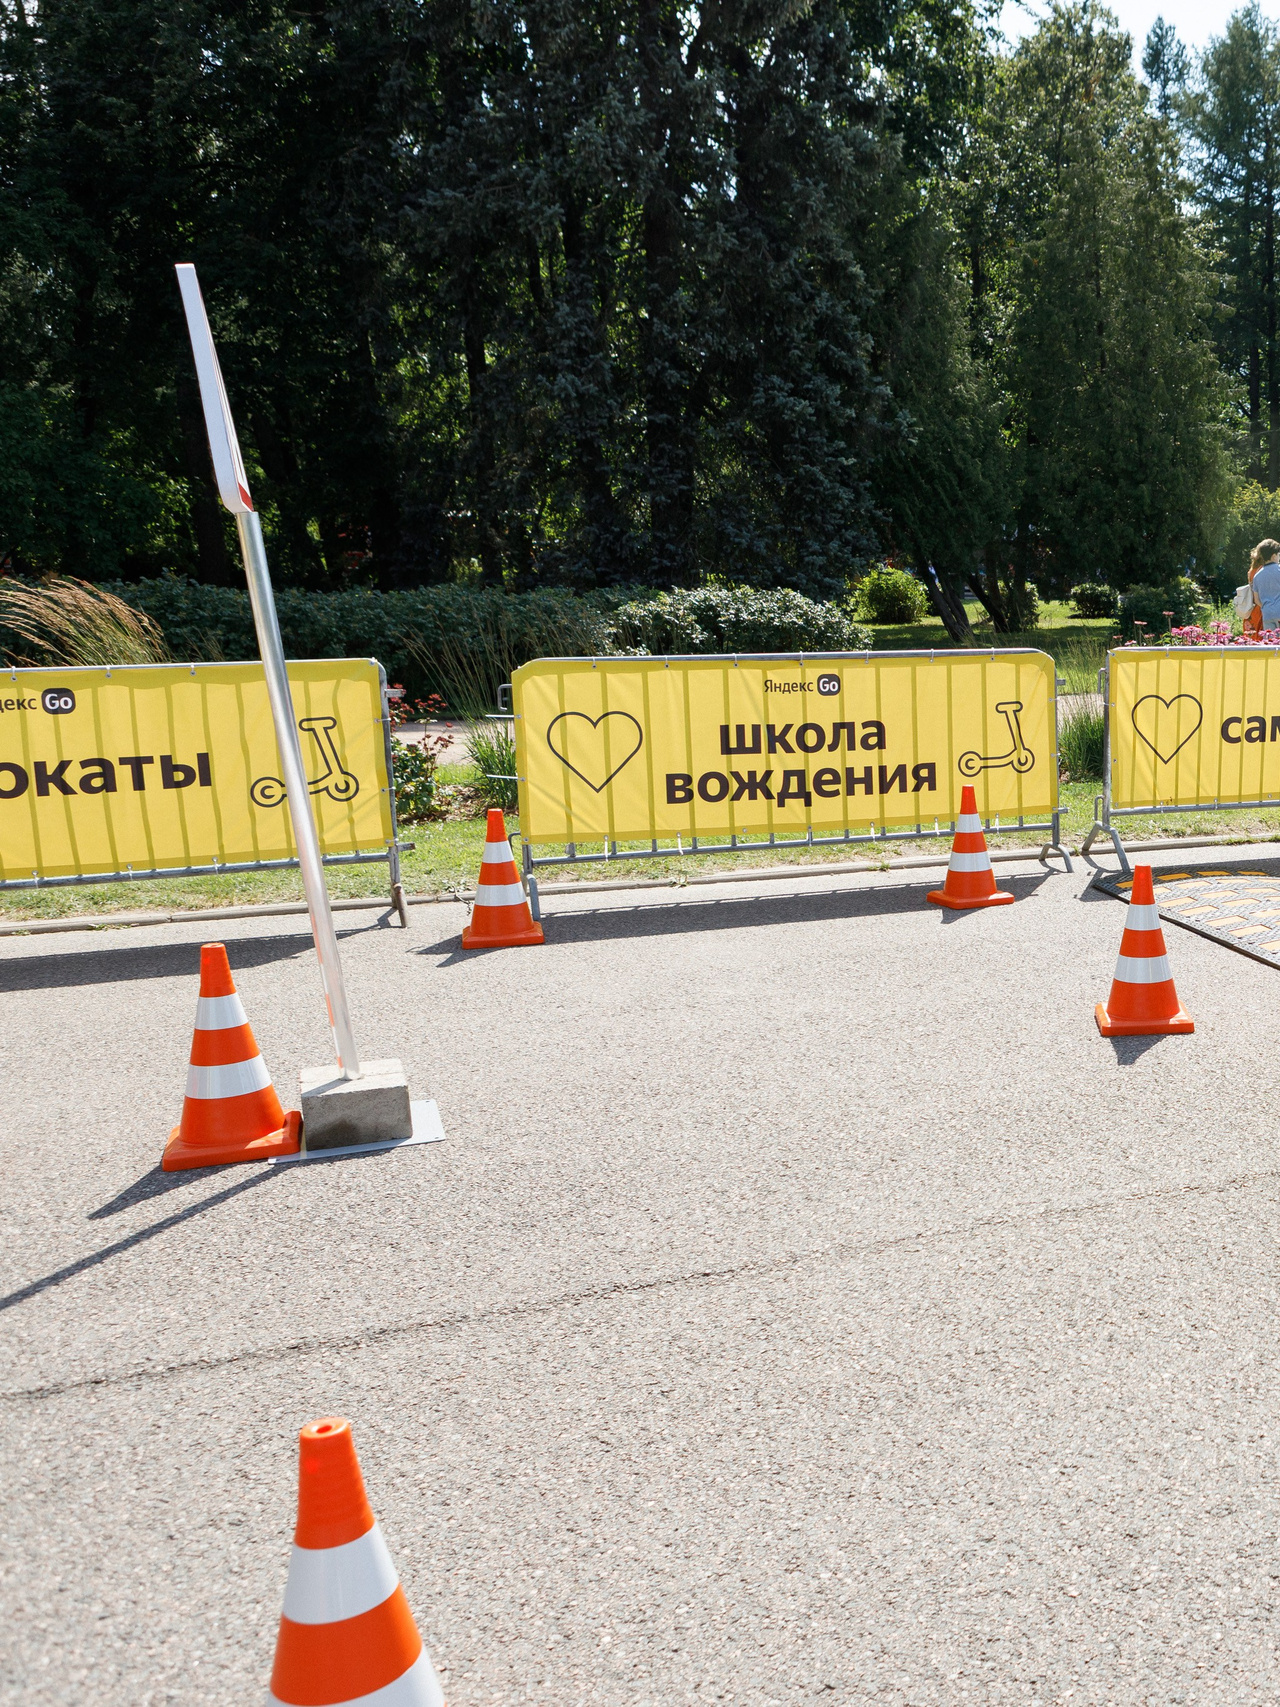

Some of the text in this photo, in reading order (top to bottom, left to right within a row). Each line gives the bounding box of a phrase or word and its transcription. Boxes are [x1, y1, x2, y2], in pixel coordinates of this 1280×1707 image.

[0, 693, 73, 713] екс Go
[764, 678, 838, 694] Яндекс Go
[720, 720, 886, 755] школа
[0, 753, 212, 799] окаты
[665, 762, 936, 808] вождения
